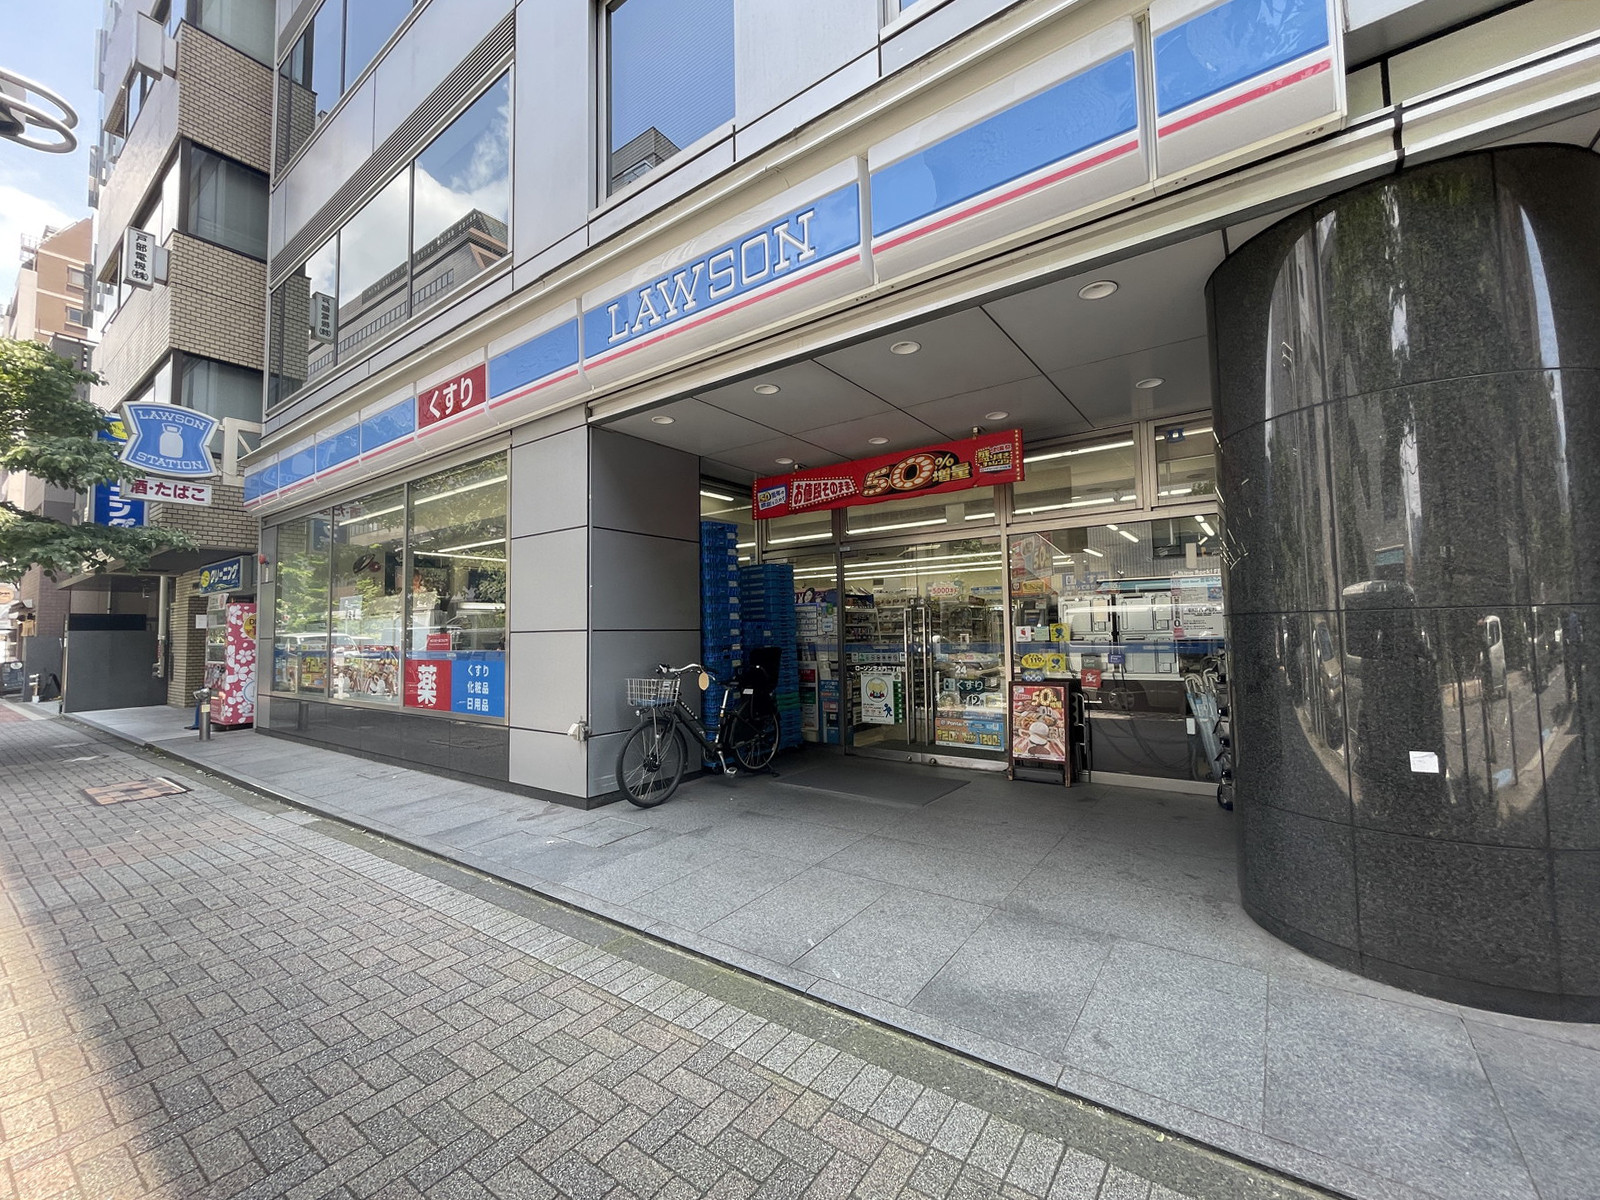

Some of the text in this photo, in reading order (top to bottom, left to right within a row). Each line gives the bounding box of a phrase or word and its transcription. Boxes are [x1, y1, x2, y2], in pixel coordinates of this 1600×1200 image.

[606, 209, 817, 345] LAWSON
[428, 378, 474, 419] くすり
[137, 410, 206, 431] LAWSON
[135, 451, 204, 470] STATION
[130, 479, 206, 502] 酒・たばこ
[793, 481, 853, 505] お値段そのまま
[210, 563, 239, 584] クリーニング
[467, 664, 489, 677] くすり
[417, 664, 437, 705] 薬
[467, 681, 489, 695] 化粧品
[956, 680, 984, 691] くすり
[467, 697, 489, 712] 日用品
